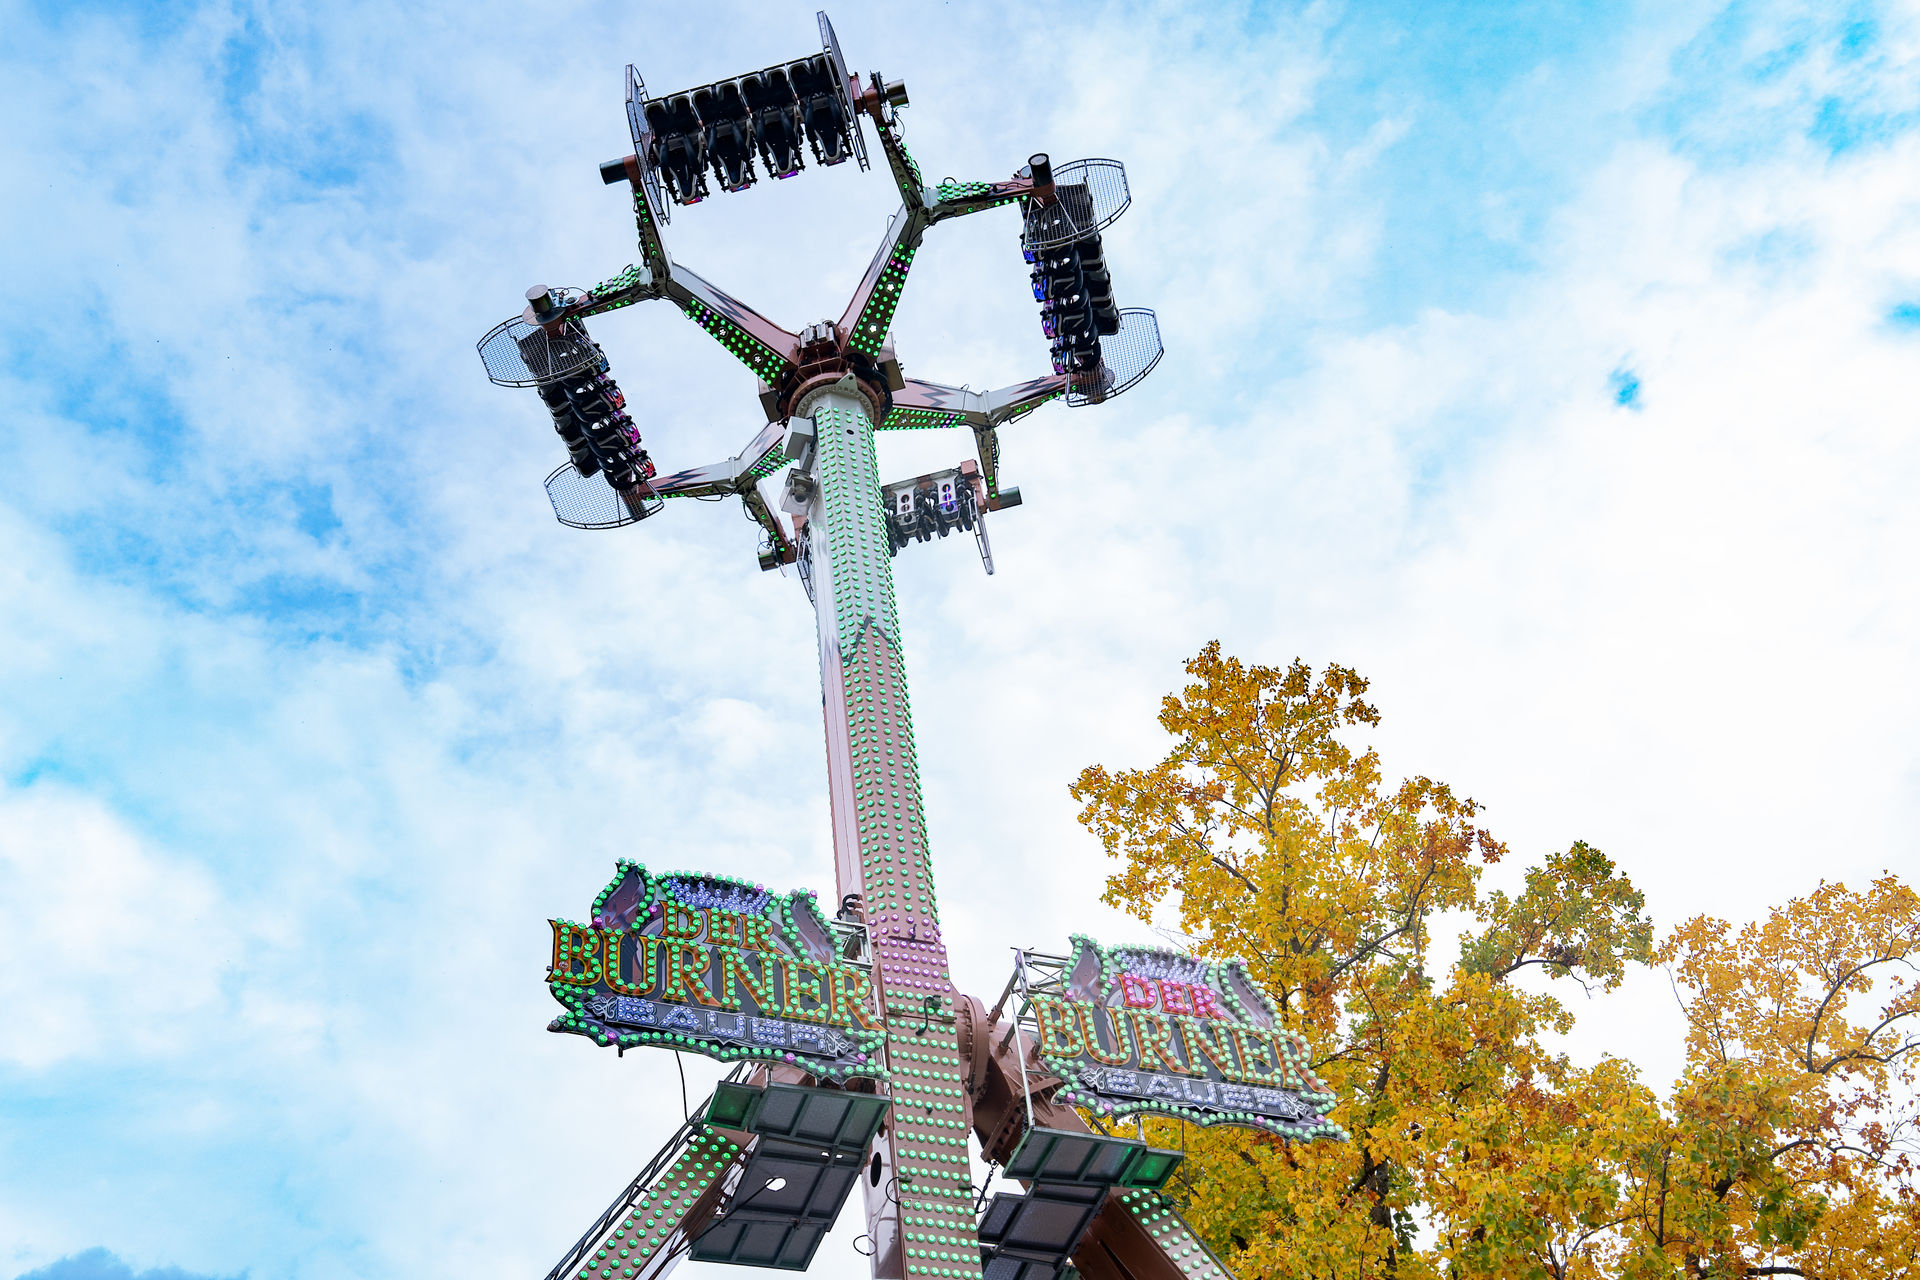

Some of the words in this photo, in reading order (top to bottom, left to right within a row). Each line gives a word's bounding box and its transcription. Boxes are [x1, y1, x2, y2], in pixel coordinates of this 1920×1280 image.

[660, 900, 785, 955] DER
[545, 919, 888, 1032] BURNER
[1116, 973, 1230, 1021] DER
[615, 996, 826, 1050] BAUER
[1031, 996, 1334, 1095] BURNER
[1105, 1068, 1289, 1113] BAUER
